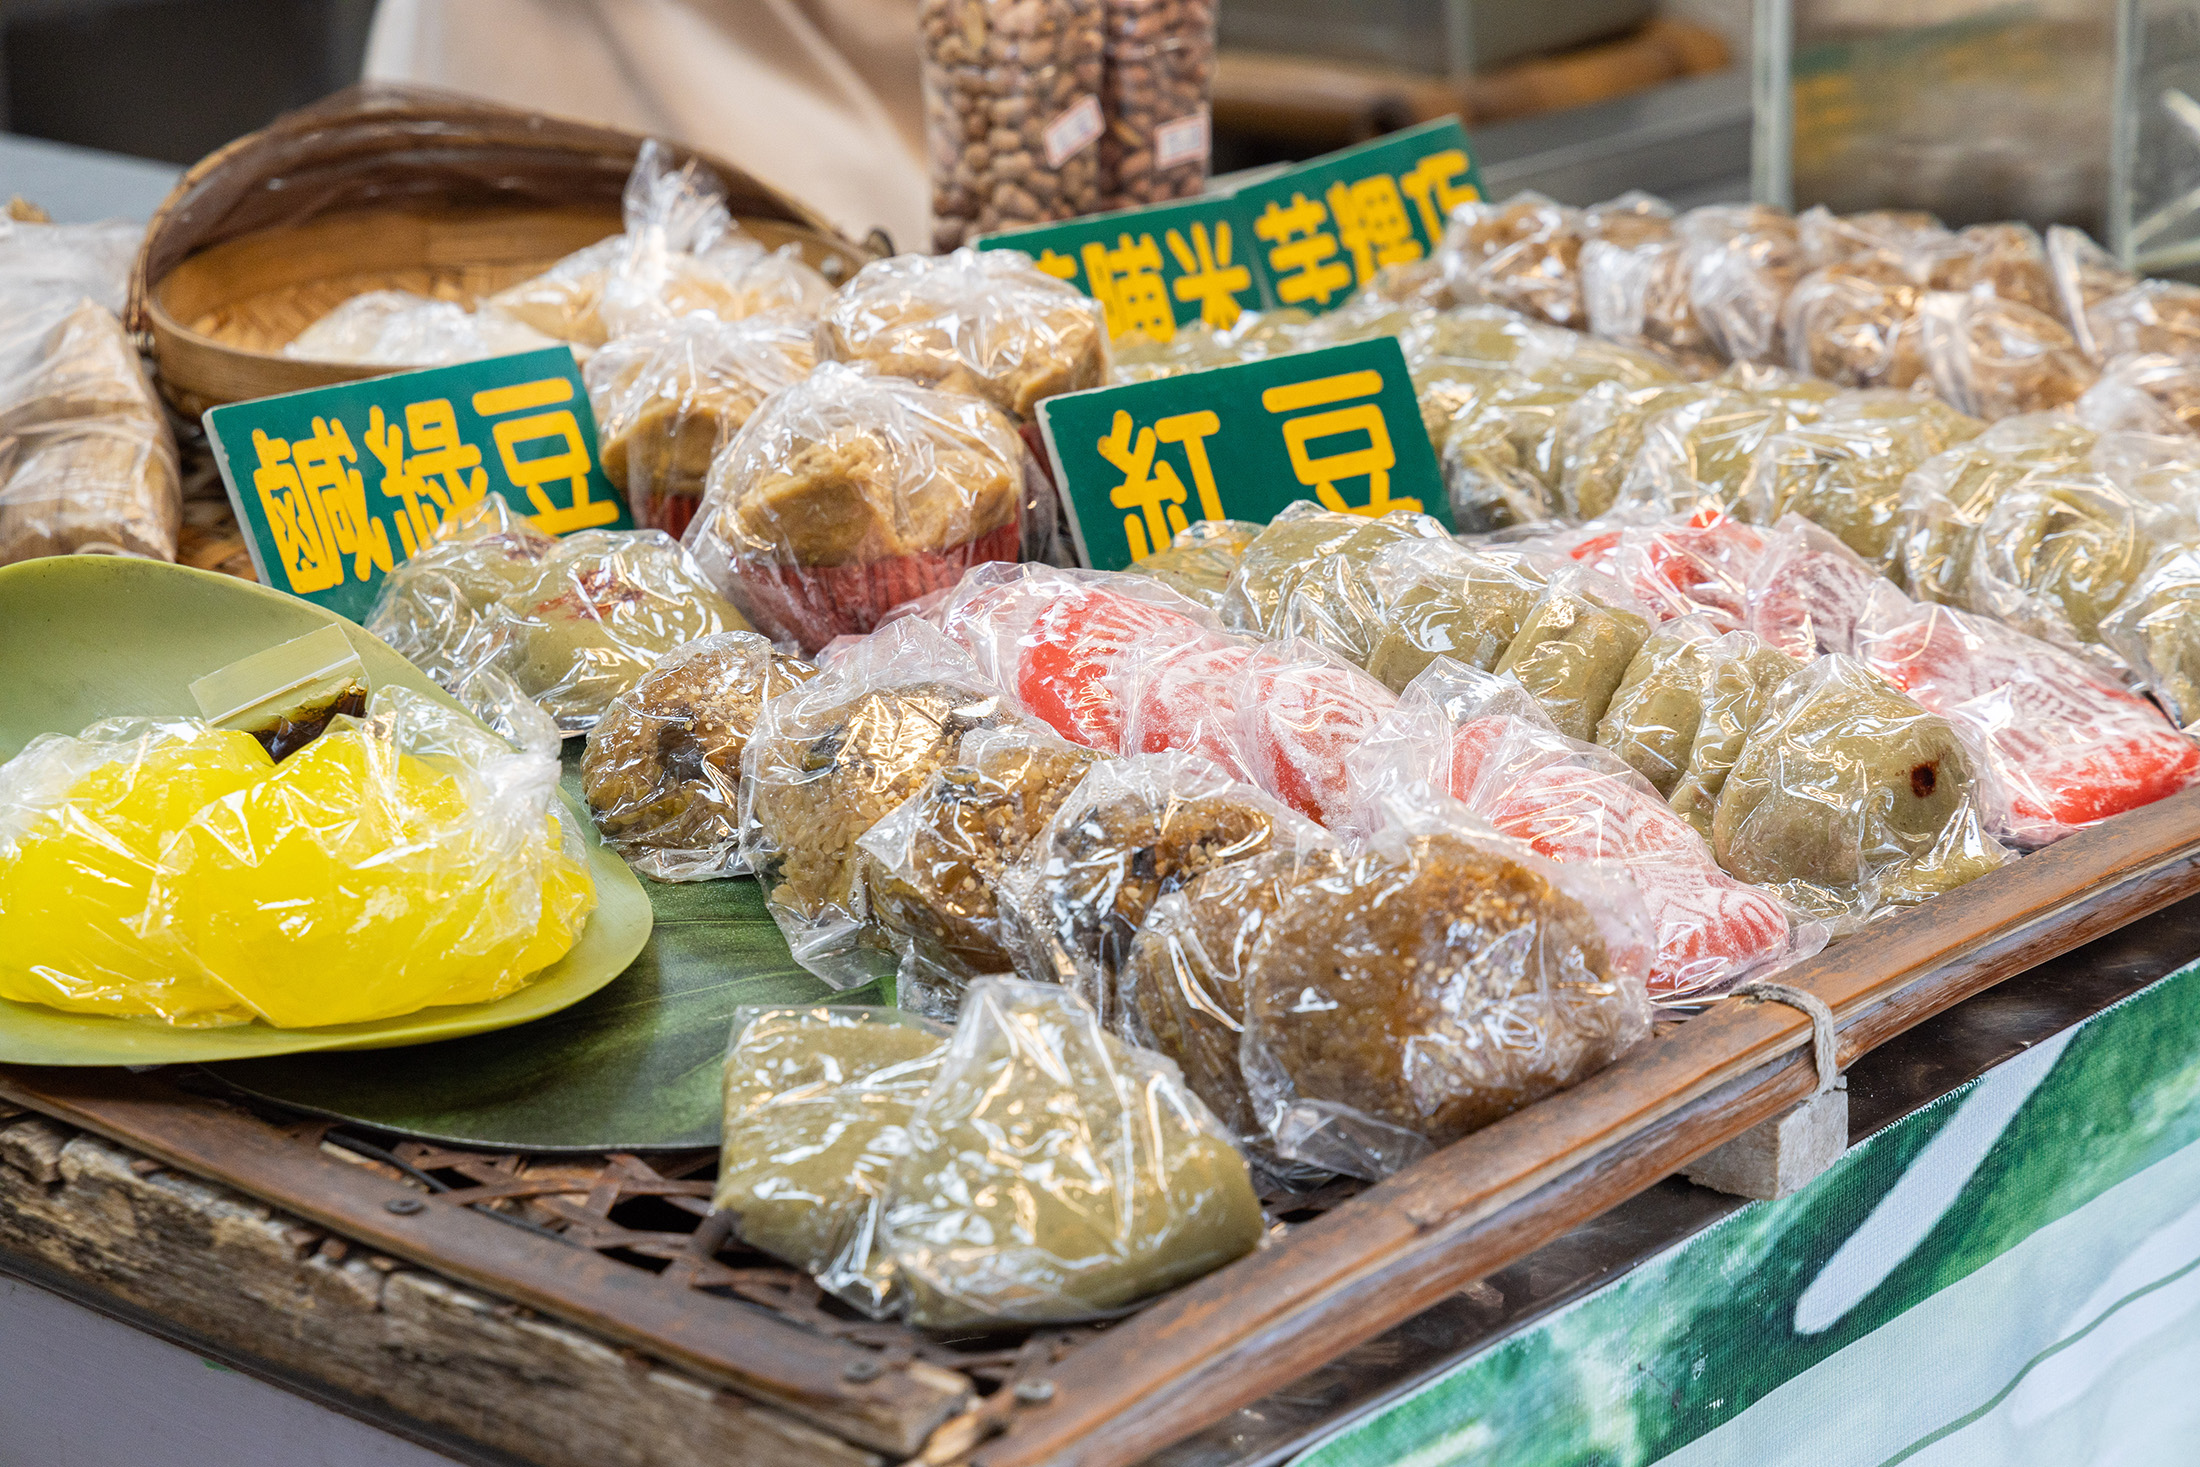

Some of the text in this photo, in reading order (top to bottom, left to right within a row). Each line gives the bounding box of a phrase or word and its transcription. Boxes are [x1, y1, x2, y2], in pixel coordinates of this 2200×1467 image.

[252, 377, 620, 595] 鹹綠豆
[1097, 369, 1425, 562] 紅豆
